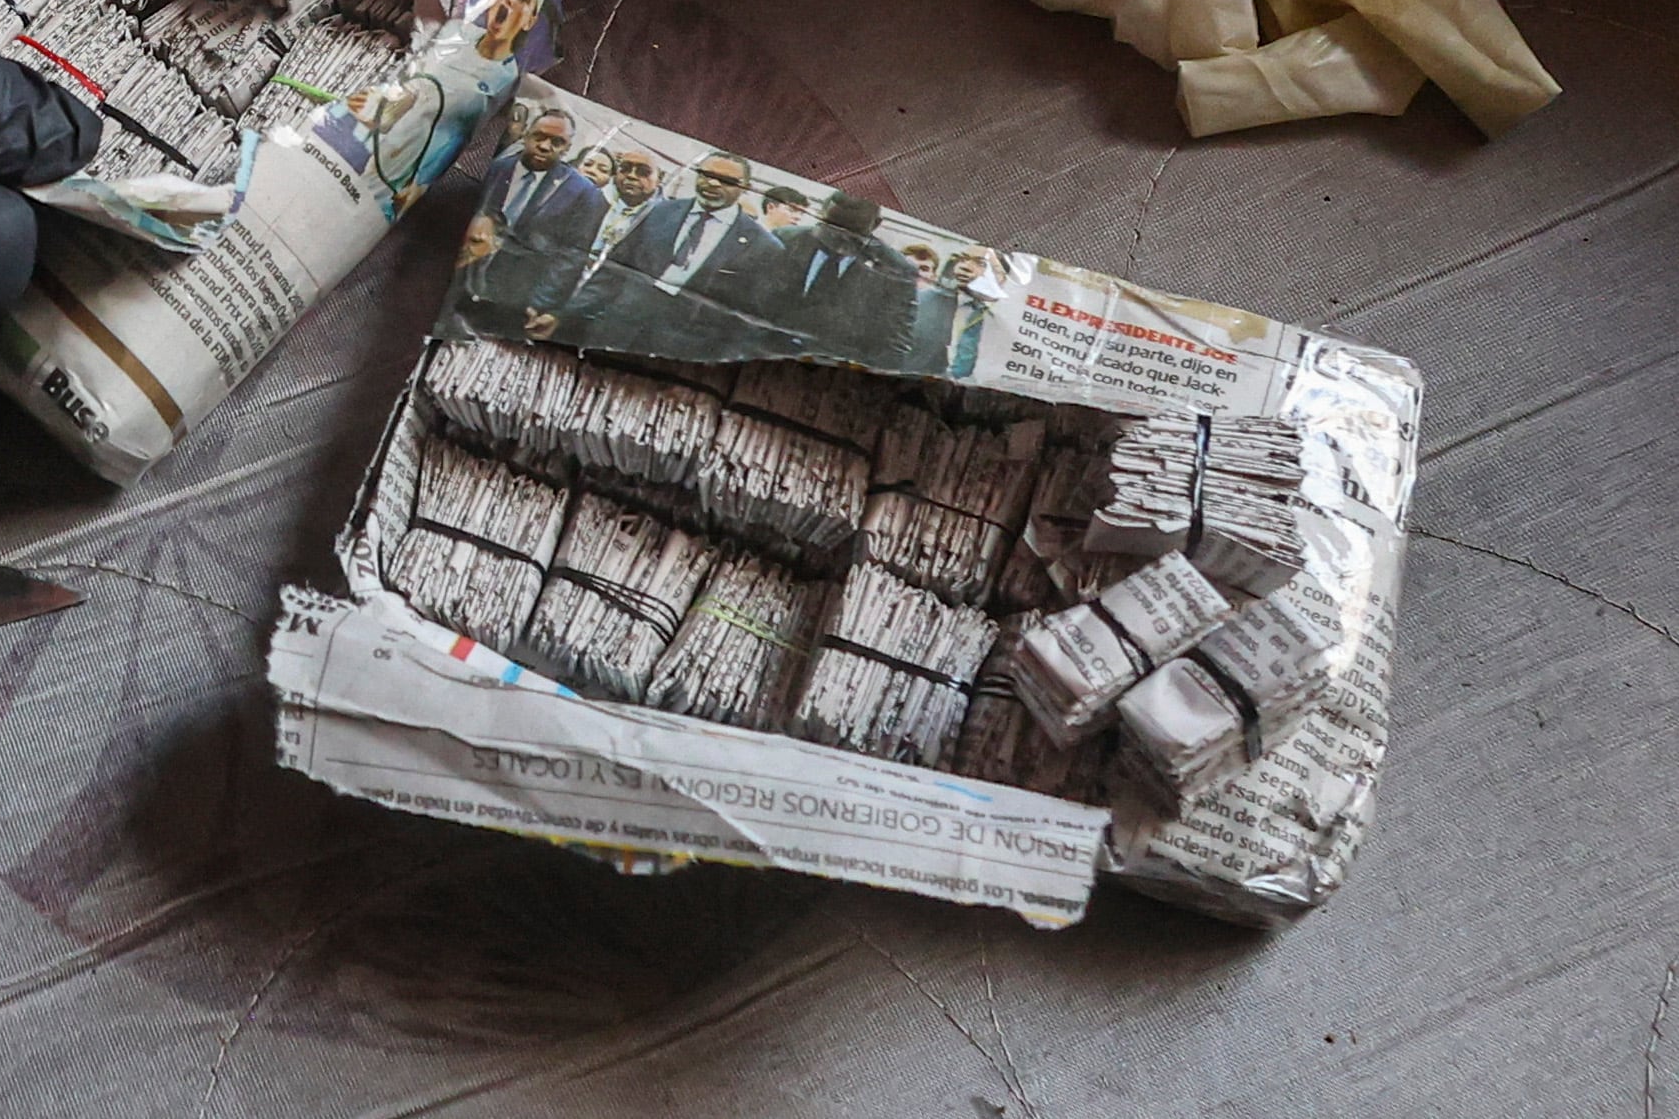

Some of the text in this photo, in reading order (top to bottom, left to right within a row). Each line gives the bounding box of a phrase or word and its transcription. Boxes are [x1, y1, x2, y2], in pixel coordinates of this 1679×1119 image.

[218, 238, 245, 265] para
[243, 259, 259, 281] los
[259, 250, 293, 295] Panamá
[187, 259, 224, 296] Grand
[220, 293, 242, 320] Prix
[232, 282, 256, 309] para
[184, 284, 222, 326] eventos
[189, 319, 205, 335] de
[201, 330, 214, 346] la
[1026, 295, 1047, 311] EL
[1052, 303, 1194, 351] EXPRESIDENTE
[1022, 311, 1069, 338] Biden,
[1106, 340, 1126, 353] su
[1128, 346, 1176, 367] parte,
[1181, 358, 1212, 374] dijo
[1215, 369, 1237, 382] en
[1006, 361, 1027, 374] en
[1030, 365, 1044, 379] la
[1012, 342, 1042, 359] son
[1092, 373, 1124, 387] con
[1128, 380, 1167, 396] todo
[1018, 326, 1225, 396] un comuicado que Jack-
[43, 369, 108, 442] Buse
[1303, 586, 1334, 606] con
[473, 747, 582, 778] LOCALES
[591, 762, 605, 784] Y
[585, 820, 605, 833] de
[784, 793, 940, 835] GOBIERNOS
[1234, 808, 1256, 827] de
[950, 820, 985, 844] DE
[1221, 853, 1244, 872] de
[1239, 837, 1285, 865] sobre
[824, 855, 885, 876] locales
[890, 866, 978, 892] gobiernos
[983, 884, 1013, 902] Los
